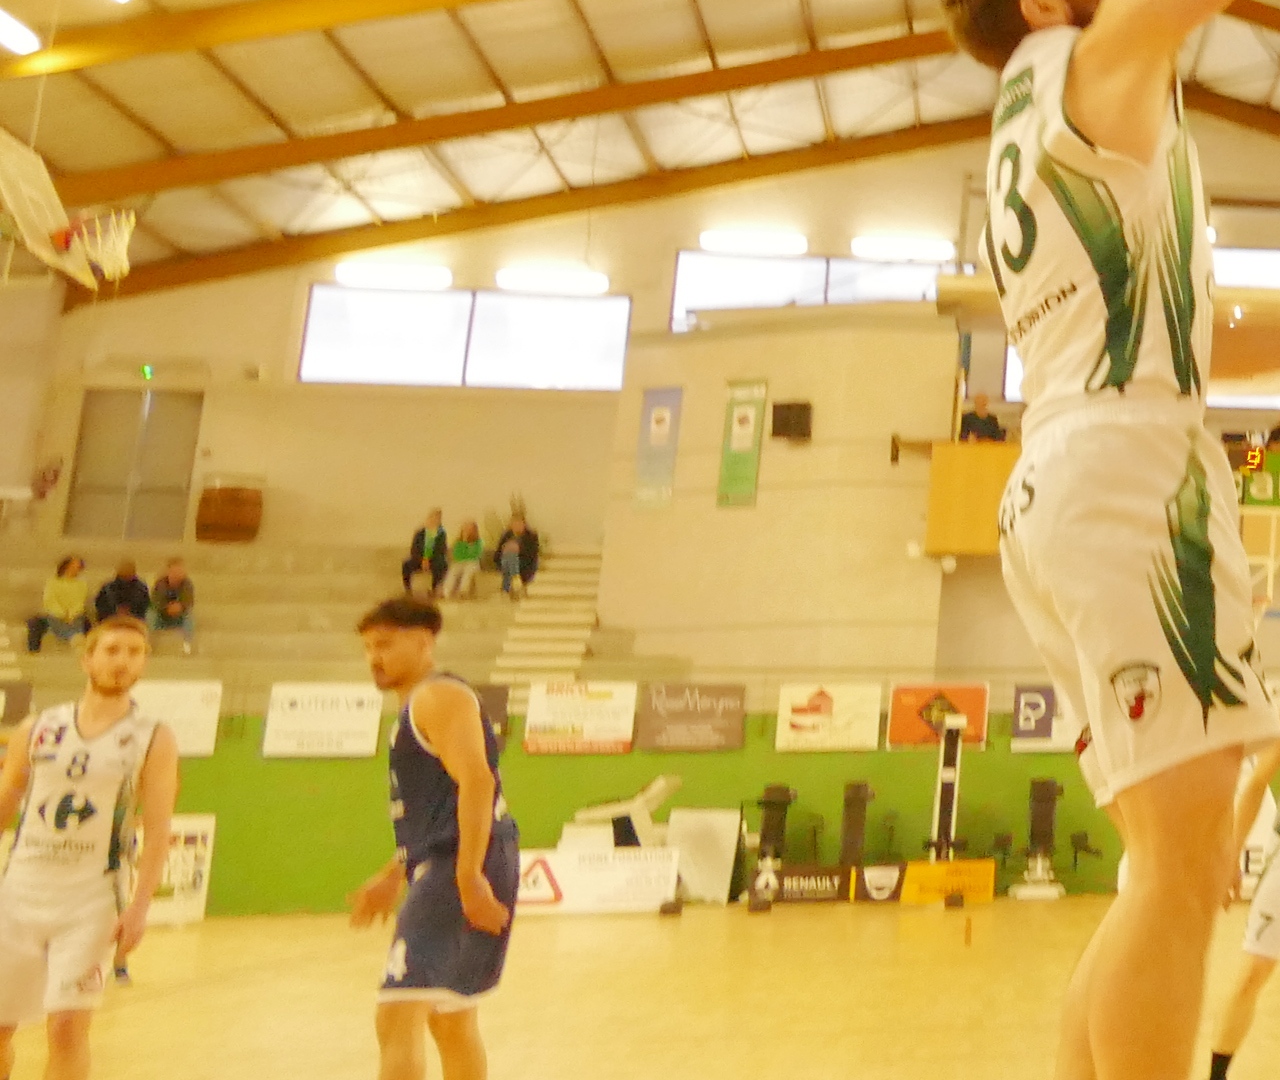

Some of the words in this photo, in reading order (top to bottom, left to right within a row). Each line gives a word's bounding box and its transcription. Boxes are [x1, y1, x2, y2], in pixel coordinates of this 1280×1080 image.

[66, 751, 90, 778] 8
[783, 875, 841, 891] RENAULT
[1255, 910, 1274, 942] 7
